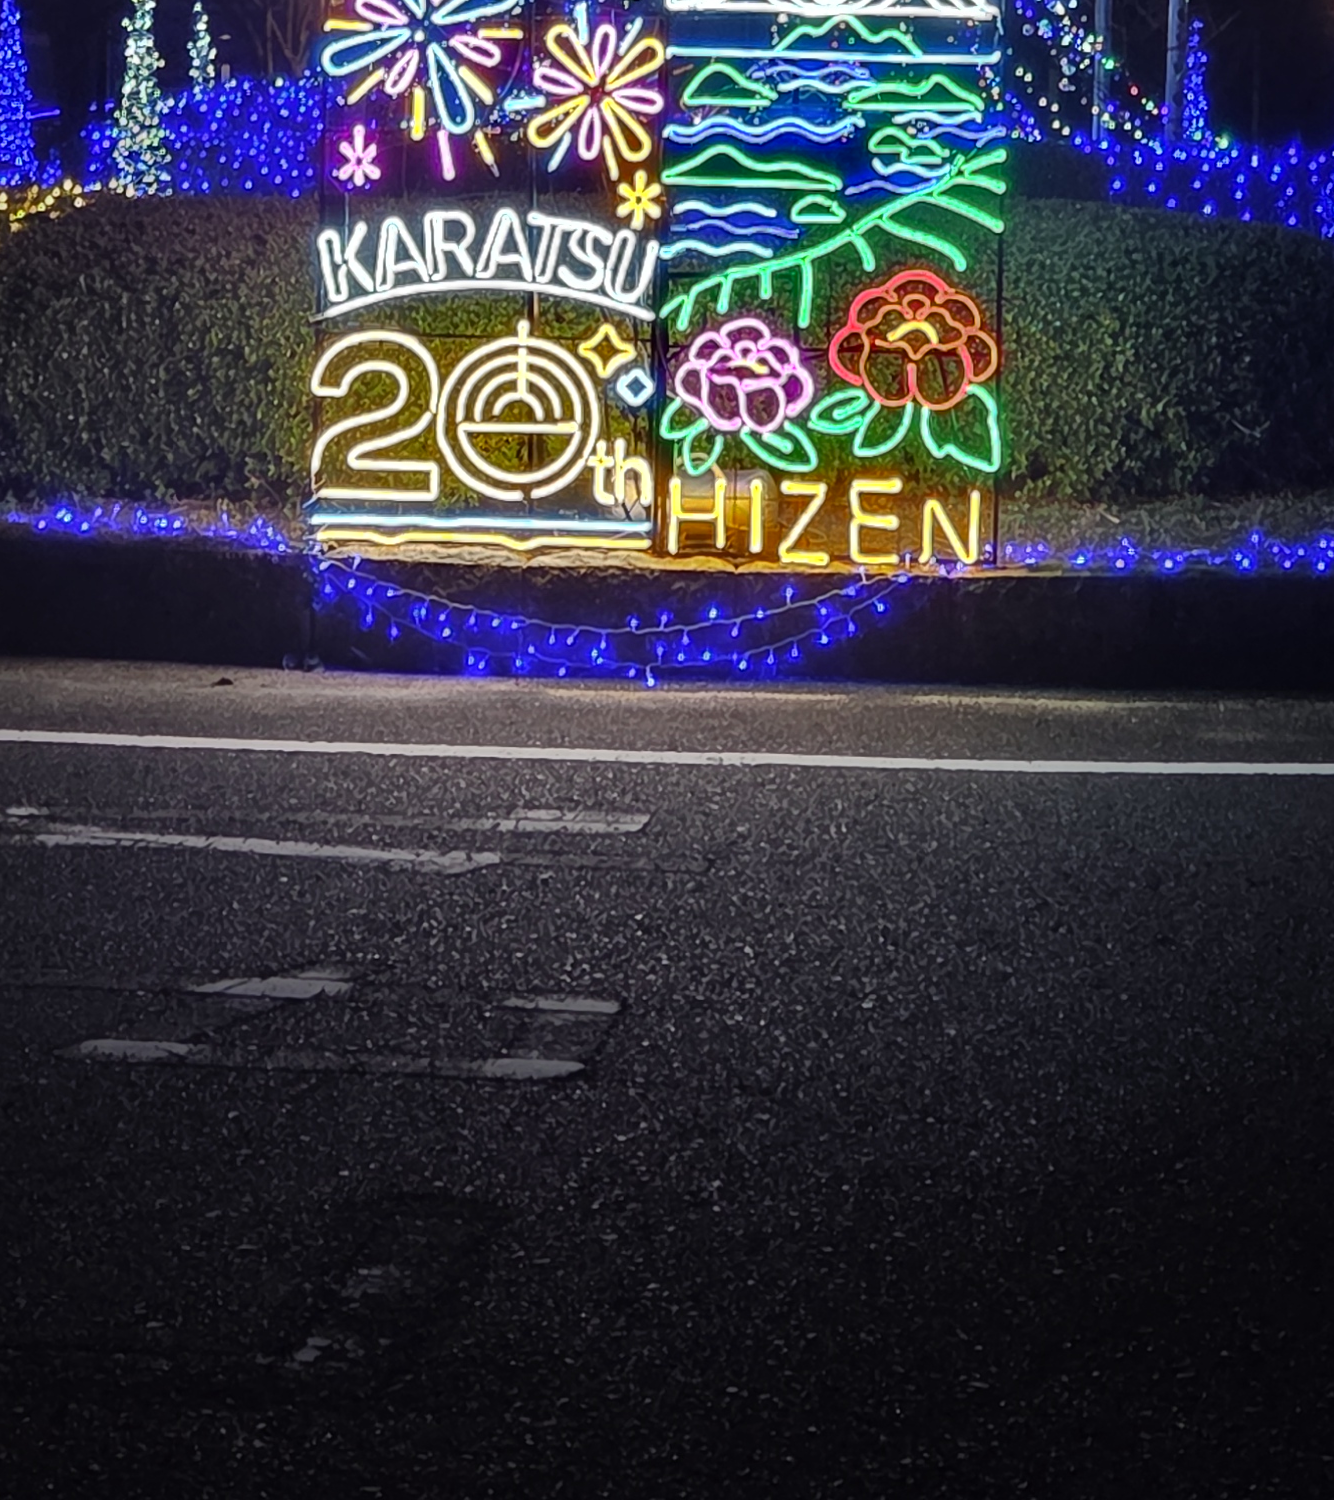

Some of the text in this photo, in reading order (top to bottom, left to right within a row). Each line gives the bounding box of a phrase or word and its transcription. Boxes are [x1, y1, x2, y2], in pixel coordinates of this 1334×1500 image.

[317, 208, 659, 303] KARATSU
[310, 320, 652, 507] 20th
[667, 476, 981, 567] HIZEN
